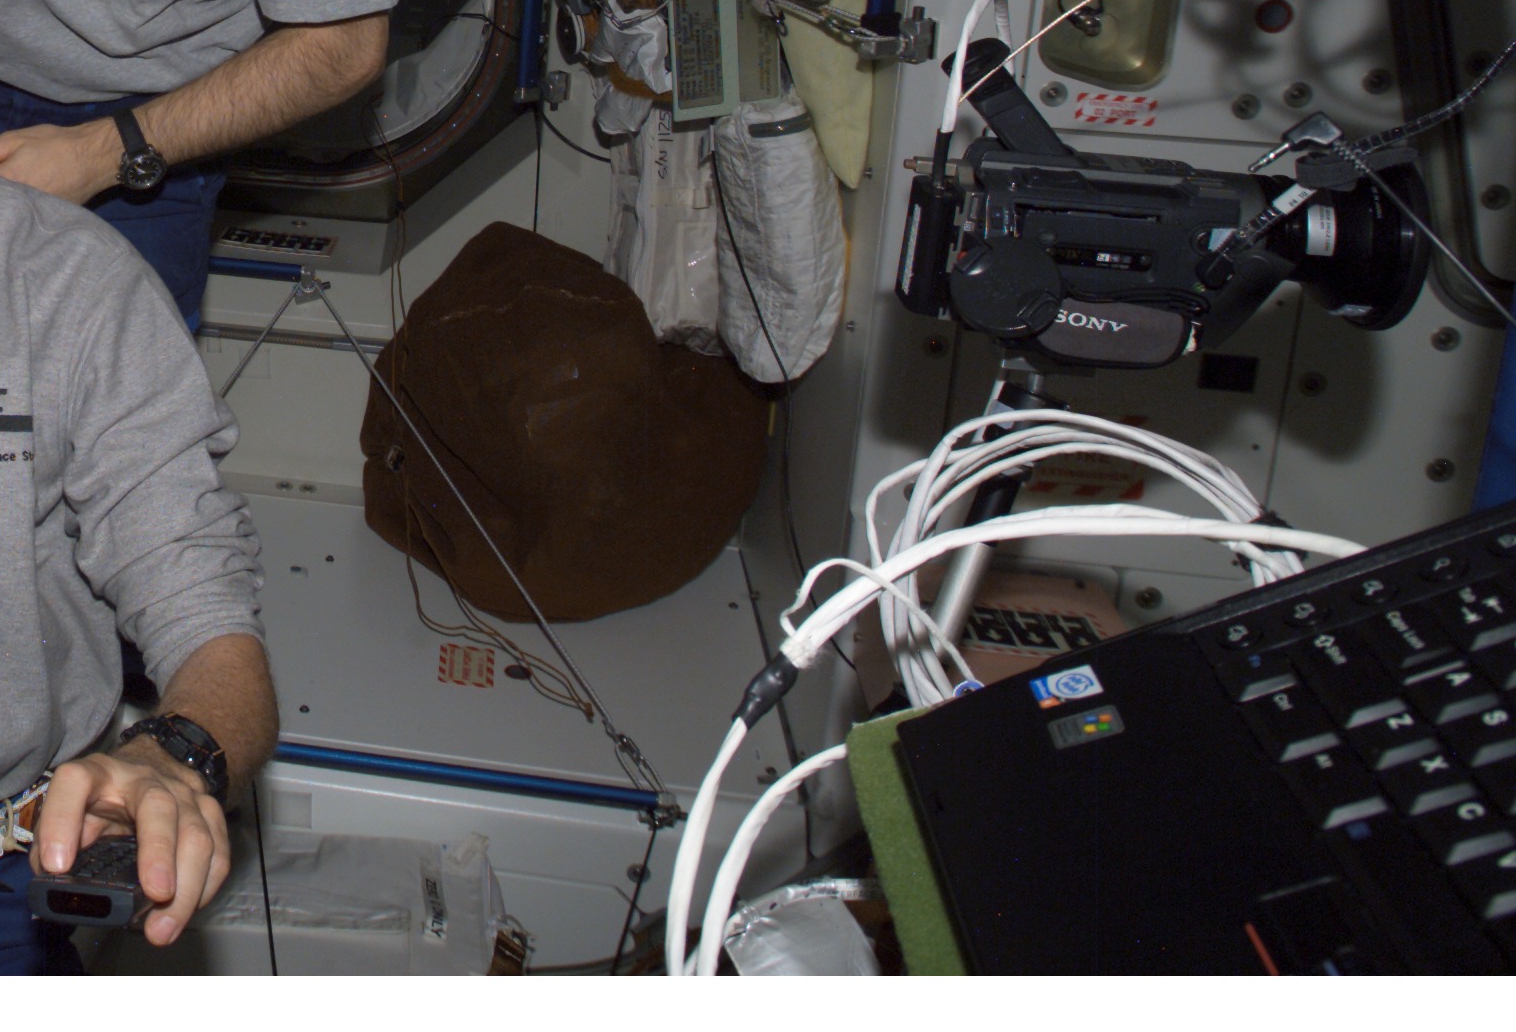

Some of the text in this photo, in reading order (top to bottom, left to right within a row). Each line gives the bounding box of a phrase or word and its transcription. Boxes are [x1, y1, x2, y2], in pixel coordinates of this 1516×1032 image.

[1053, 308, 1128, 334] SONY
[1445, 671, 1472, 687] A
[1385, 711, 1415, 731] Z
[1481, 708, 1510, 728] S
[1418, 754, 1451, 775] X
[1456, 801, 1486, 821] C
